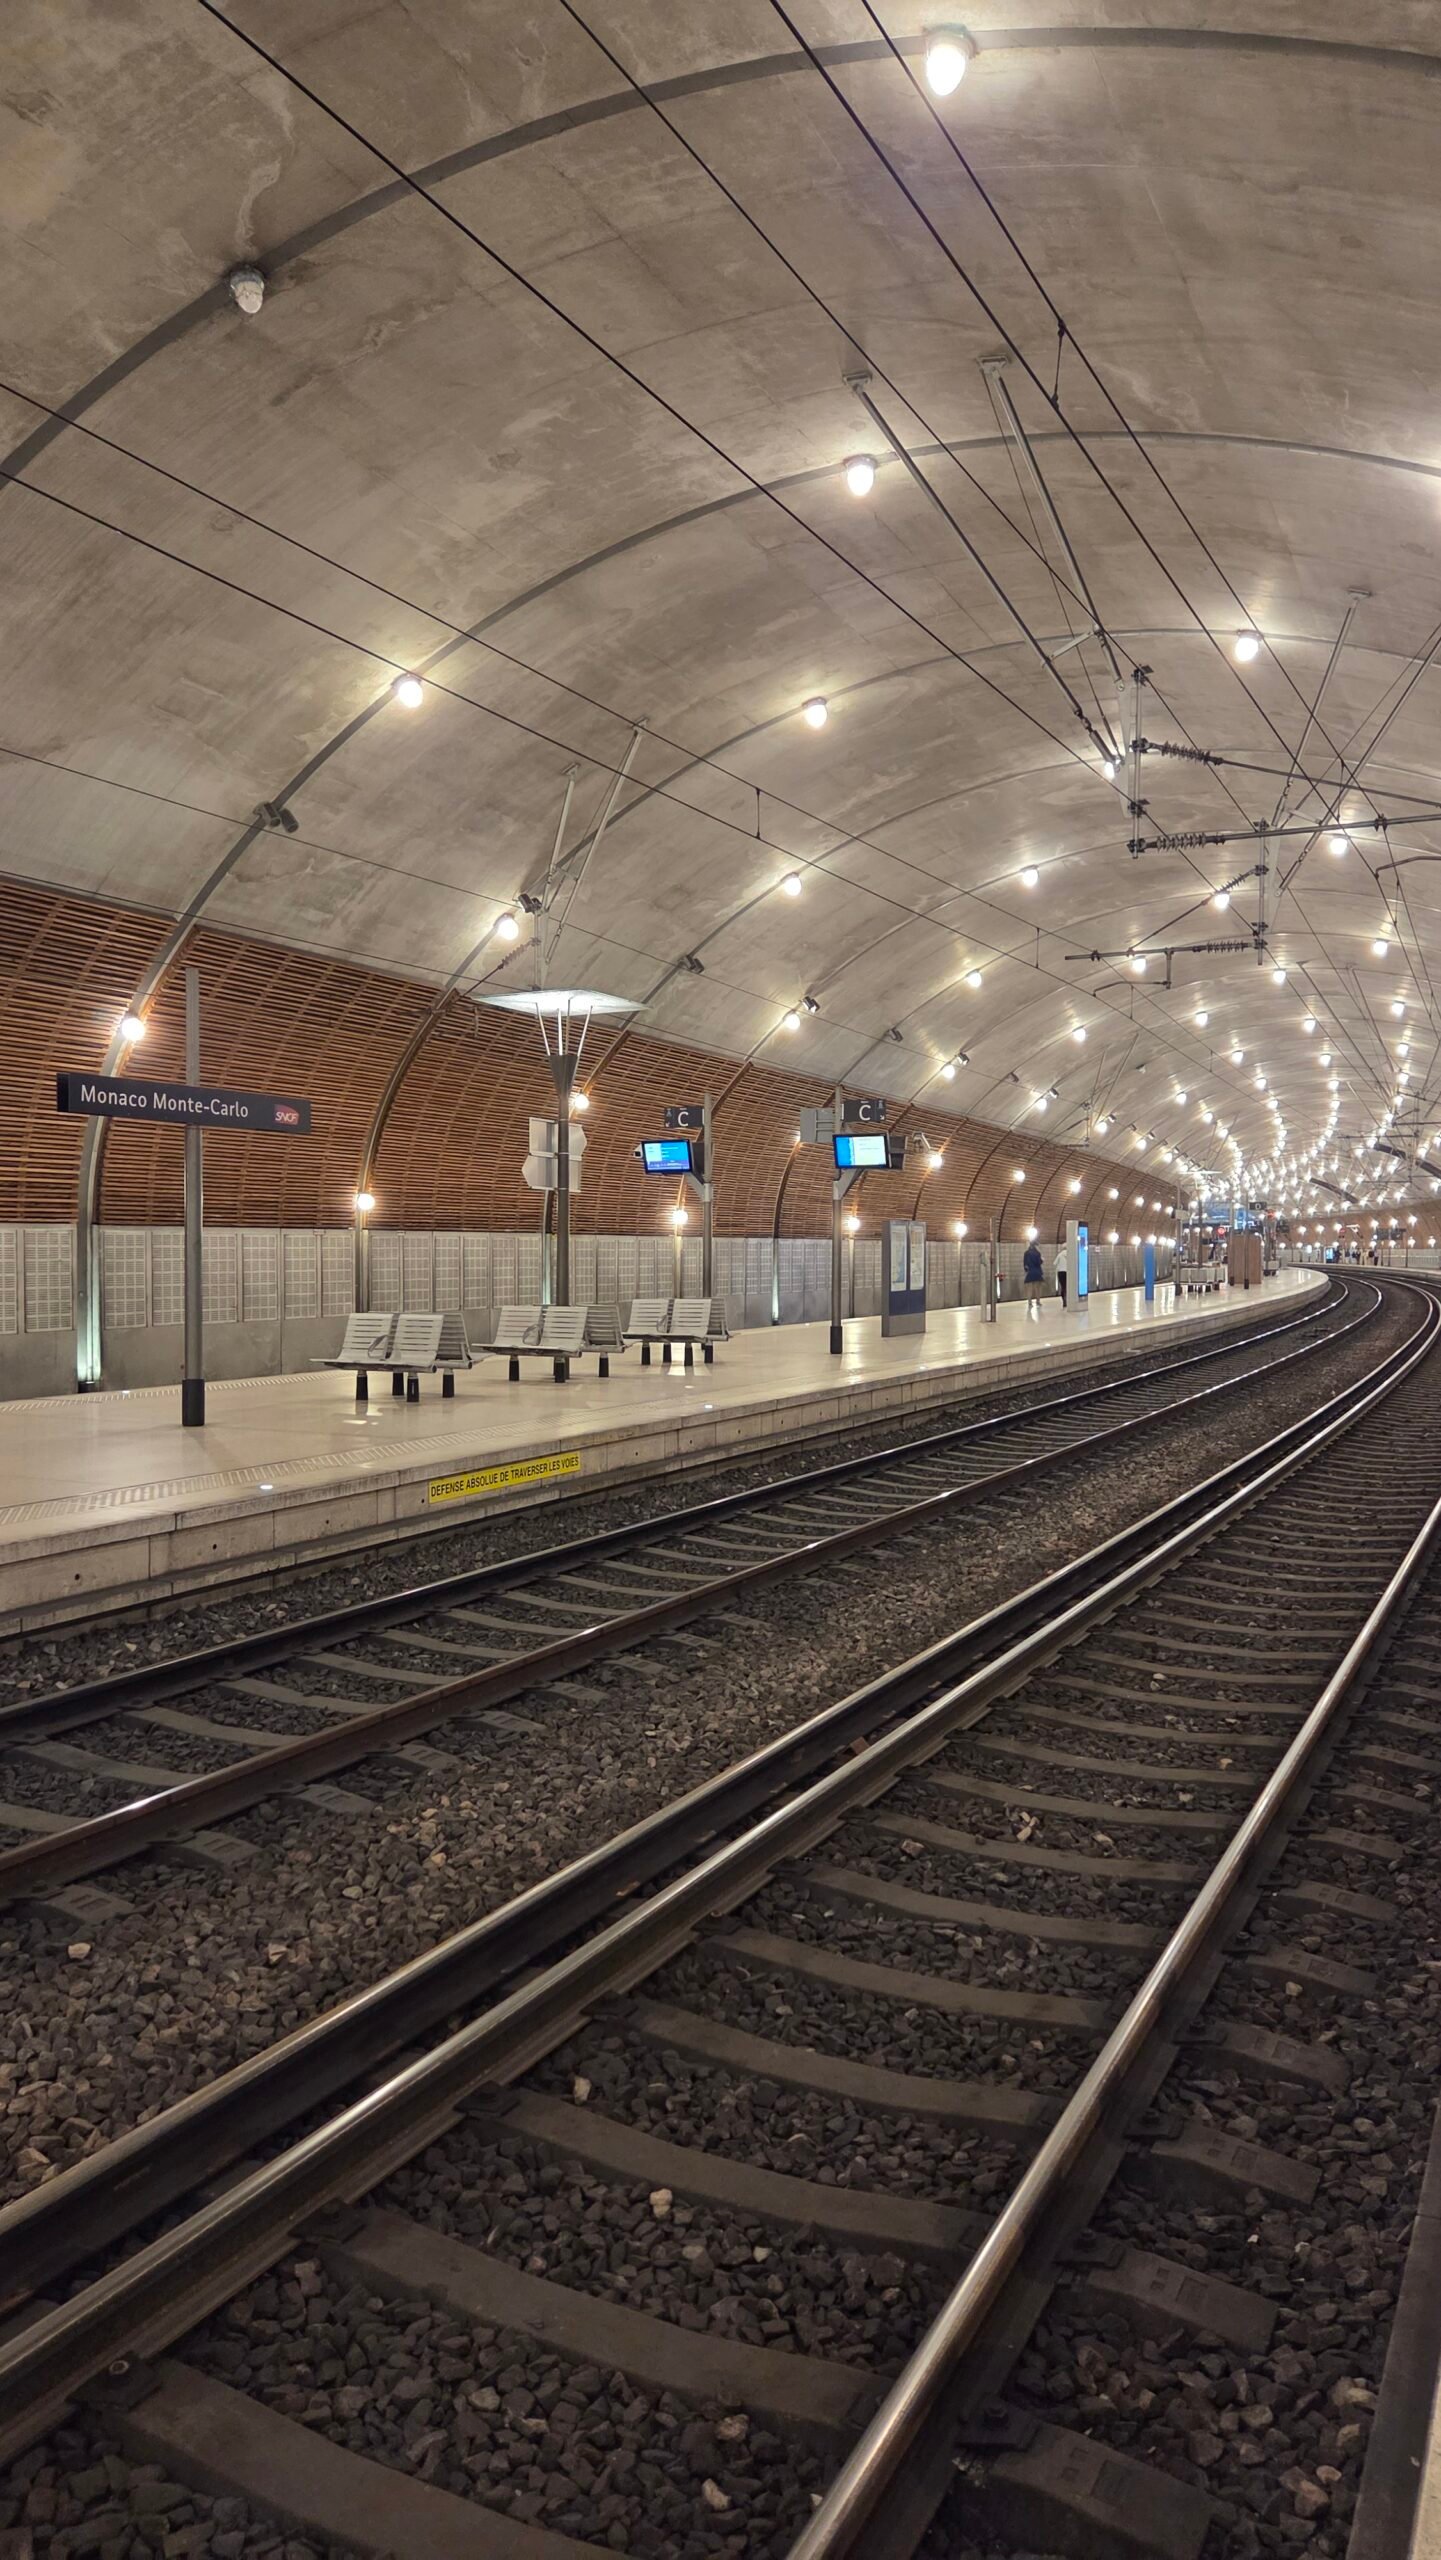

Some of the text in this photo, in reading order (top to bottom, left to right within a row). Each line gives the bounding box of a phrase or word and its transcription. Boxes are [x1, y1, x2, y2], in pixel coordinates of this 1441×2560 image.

[80, 1084, 249, 1118] Monaco Monte-Carlo
[275, 1111, 298, 1123] SNCF
[677, 1111, 689, 1127] C
[858, 1104, 872, 1121] C
[431, 1456, 579, 1497] DEFENSE ABSOLUE DE TRAVERSER LES VOIES
